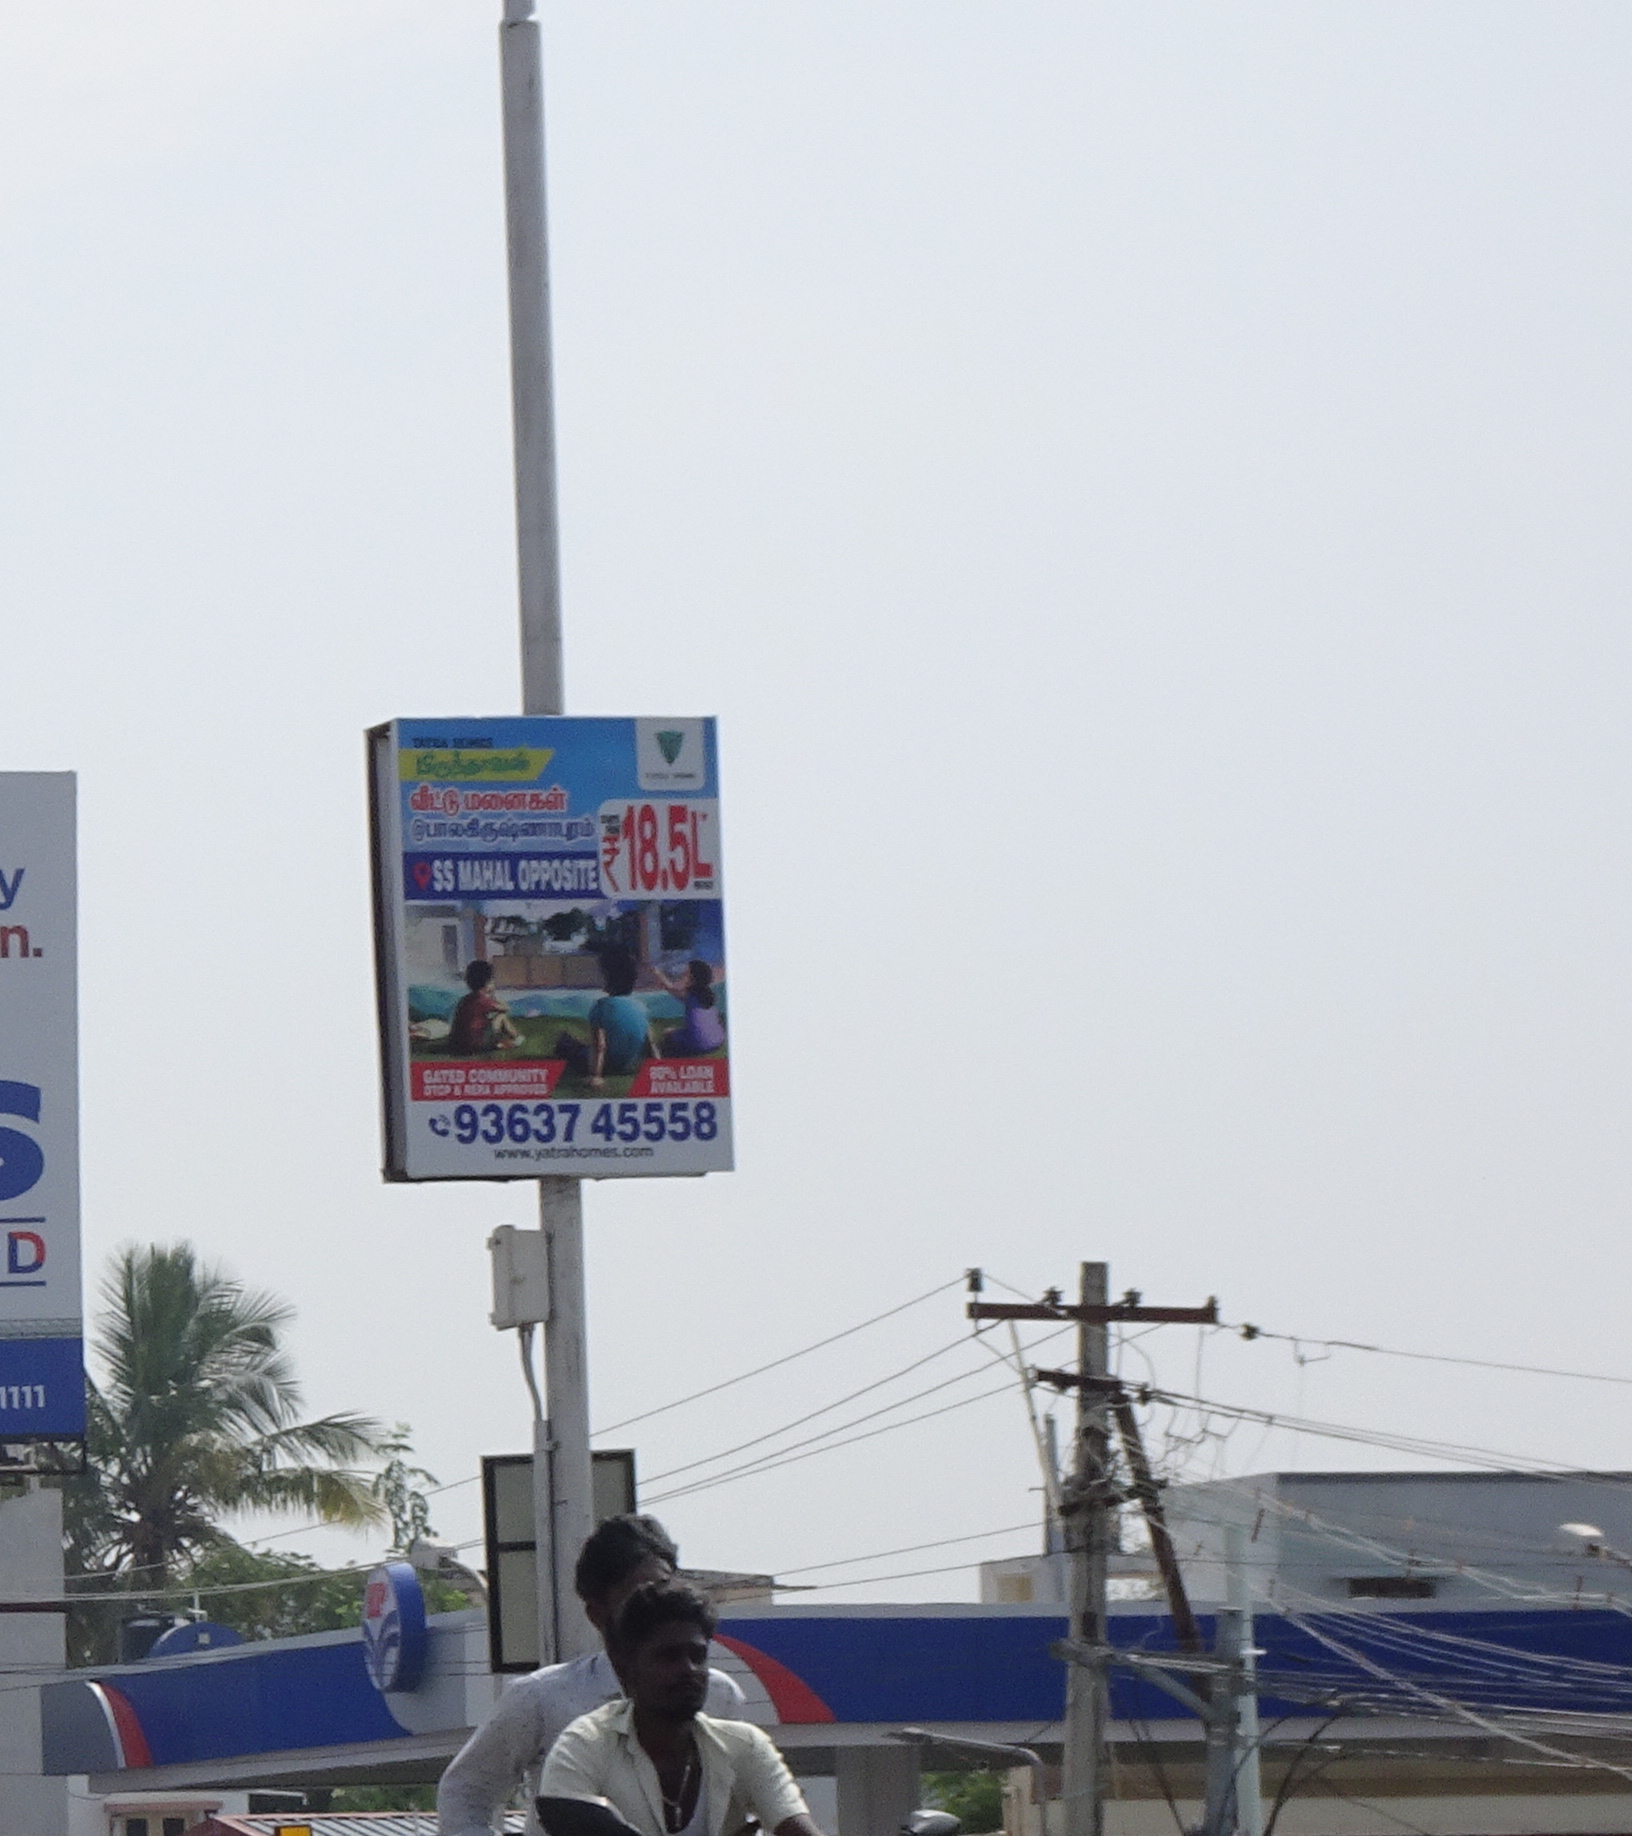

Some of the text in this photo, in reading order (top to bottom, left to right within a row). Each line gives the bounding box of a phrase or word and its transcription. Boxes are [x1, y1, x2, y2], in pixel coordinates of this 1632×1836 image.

[432, 859, 598, 892] SS MAHAL OPPOSITE
[454, 1101, 717, 1144] 93637 45558
